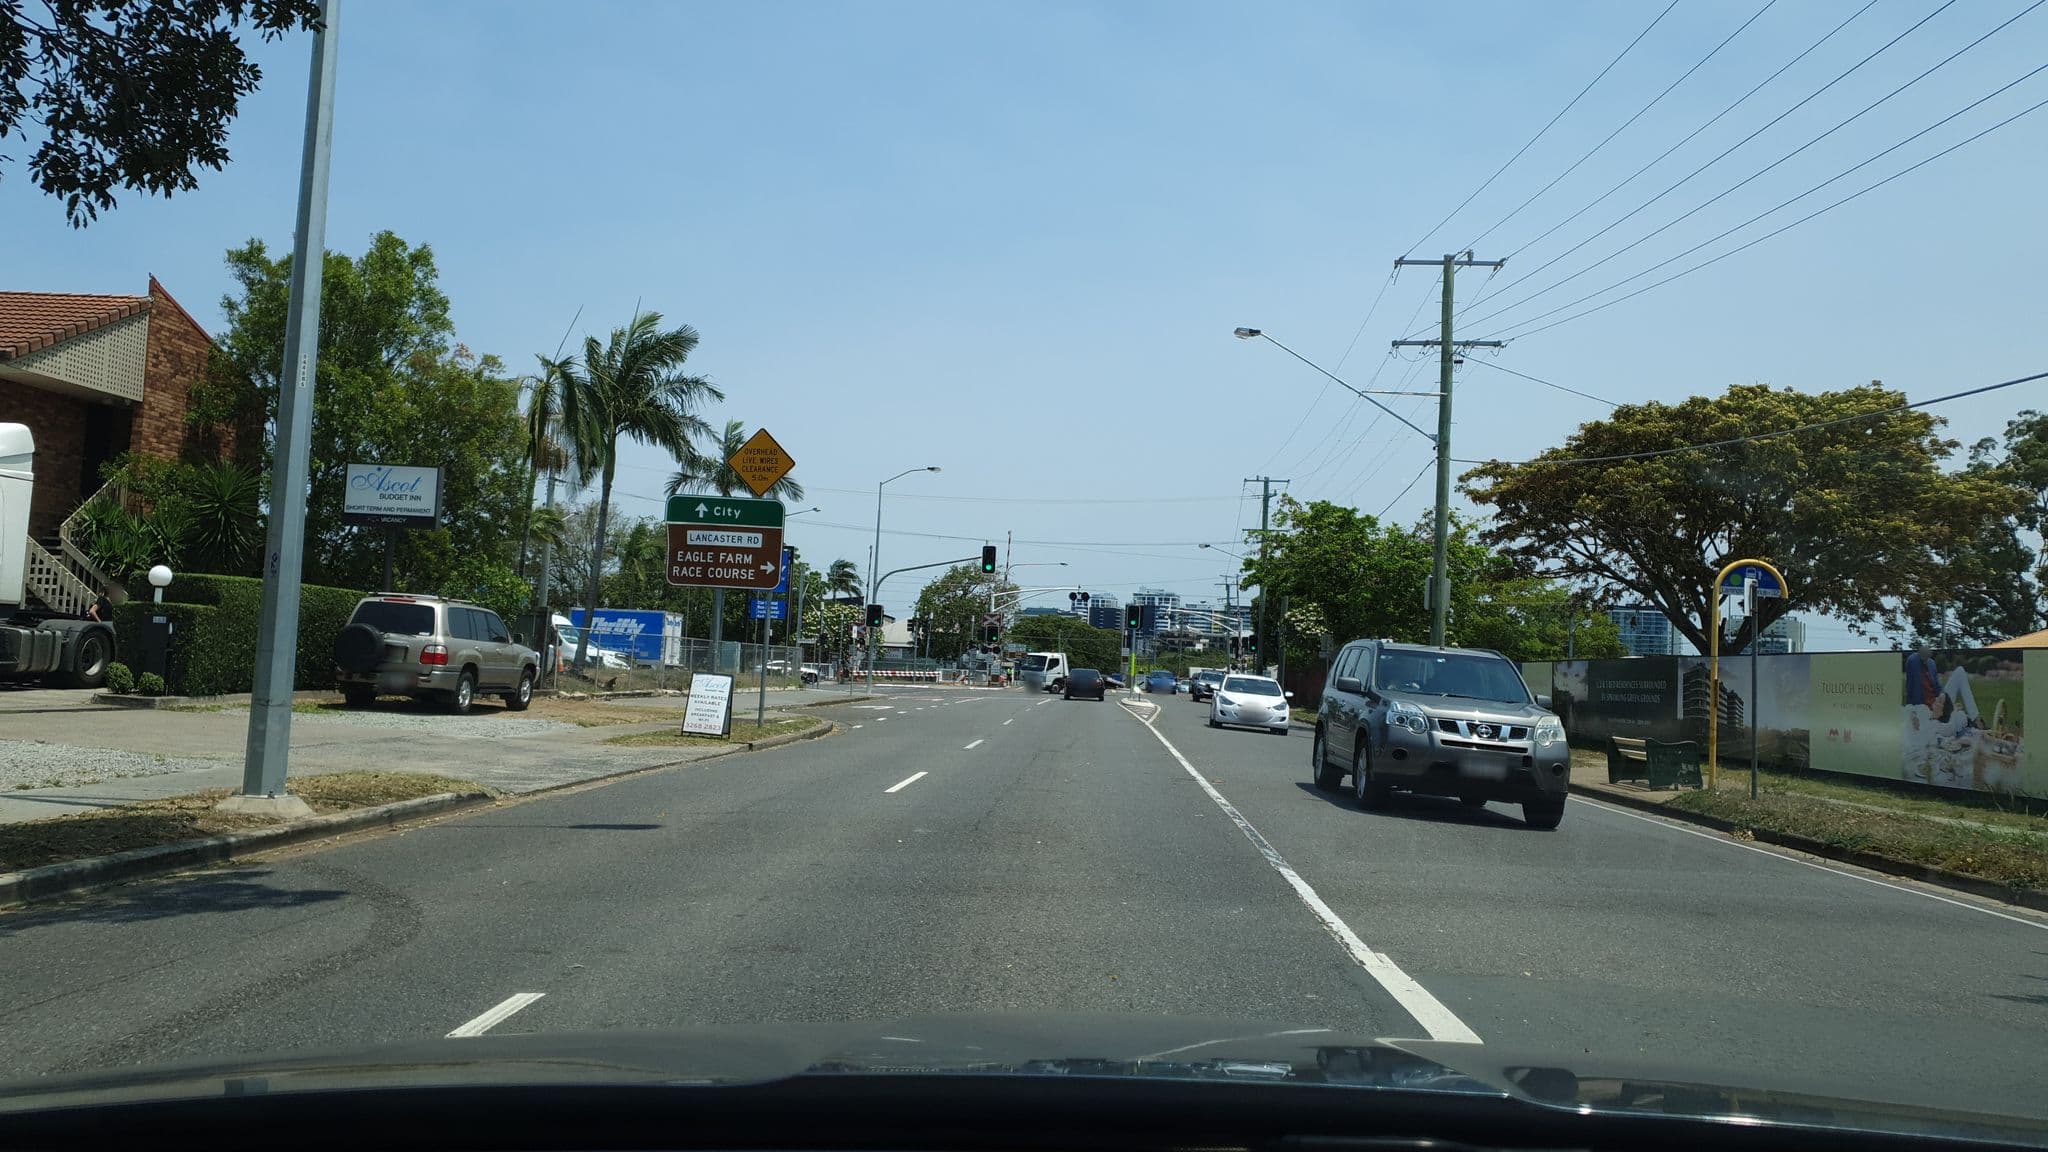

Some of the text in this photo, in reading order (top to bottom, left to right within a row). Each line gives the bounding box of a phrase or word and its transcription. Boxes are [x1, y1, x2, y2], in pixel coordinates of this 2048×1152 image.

[745, 448, 777, 456] OVERHEAD
[742, 465, 778, 473] CLEARANCE
[351, 467, 422, 492] Ascot
[379, 493, 422, 502] BUDGET INN
[713, 507, 741, 519] City
[690, 534, 759, 545] LANCASTER RD
[677, 551, 752, 565] EAGLE FARM
[672, 566, 755, 580] RACE COURSE
[1821, 682, 1885, 695] TULLOCH HOUSE
